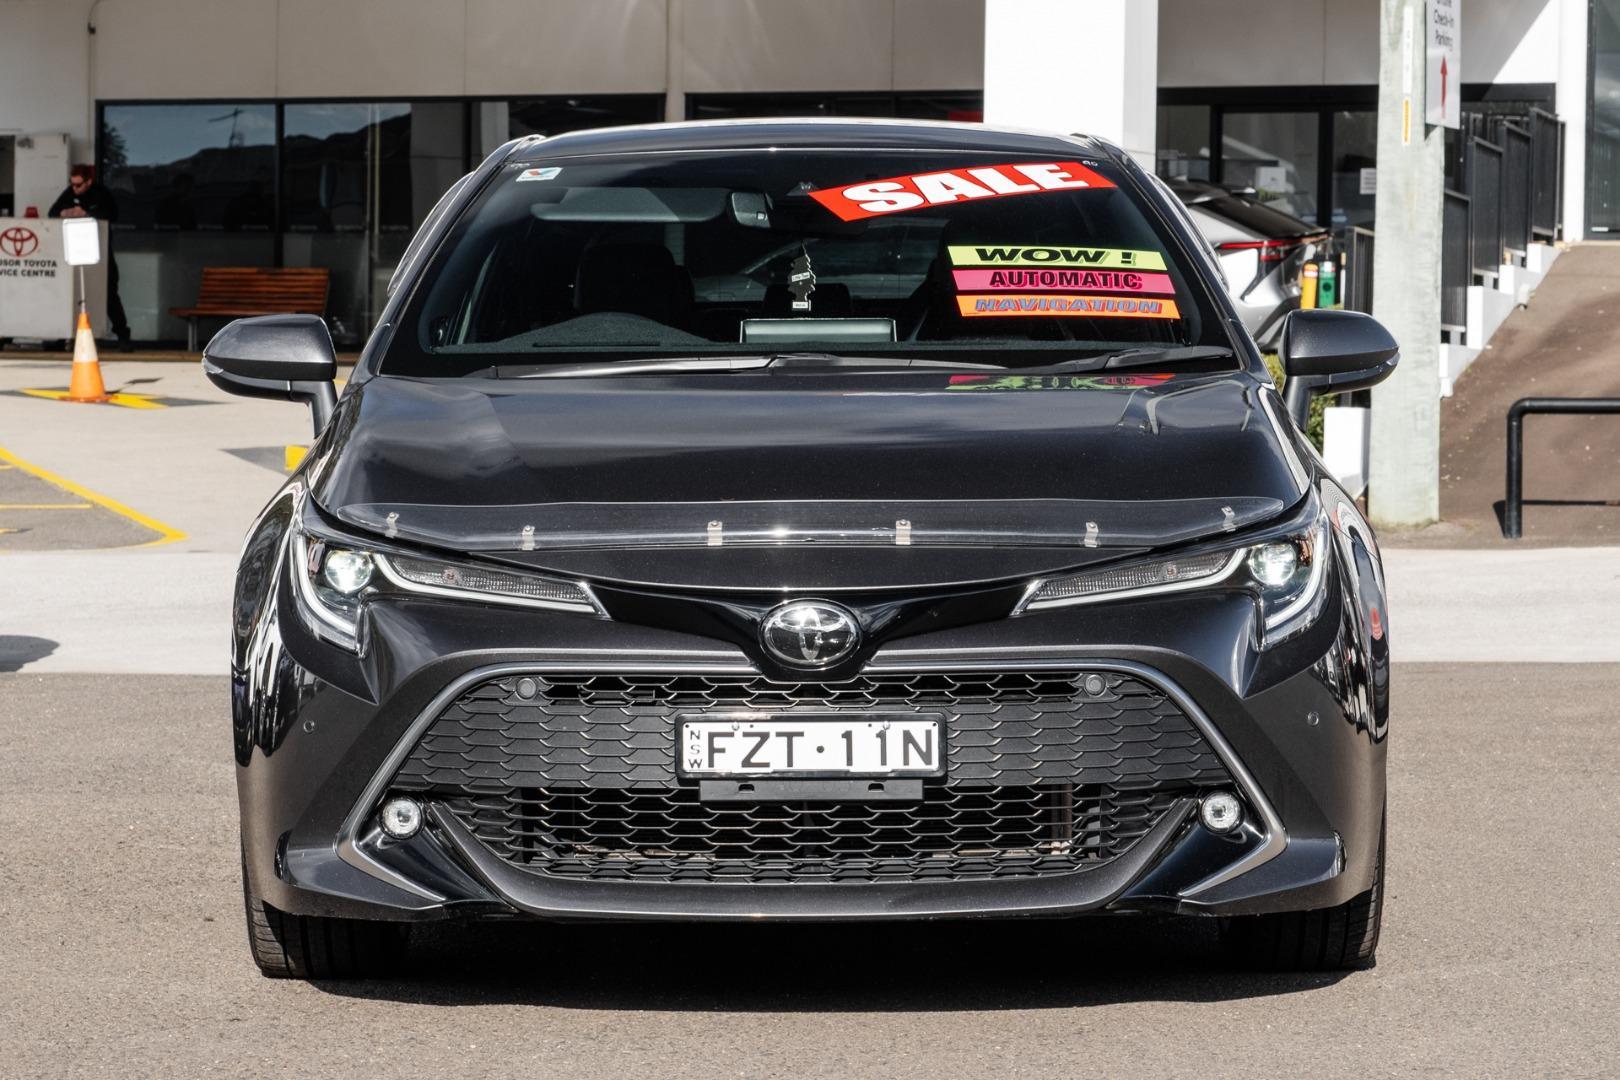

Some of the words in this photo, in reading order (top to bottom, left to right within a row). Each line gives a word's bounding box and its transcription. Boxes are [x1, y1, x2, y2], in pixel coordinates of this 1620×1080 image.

[842, 162, 1090, 213] SALE
[976, 247, 1110, 263] WOW
[24, 259, 58, 268] TOYOTA
[20, 269, 56, 278] CENTRE
[989, 271, 1143, 290] AUTOMATIC
[974, 298, 1163, 314] NAVIGATION
